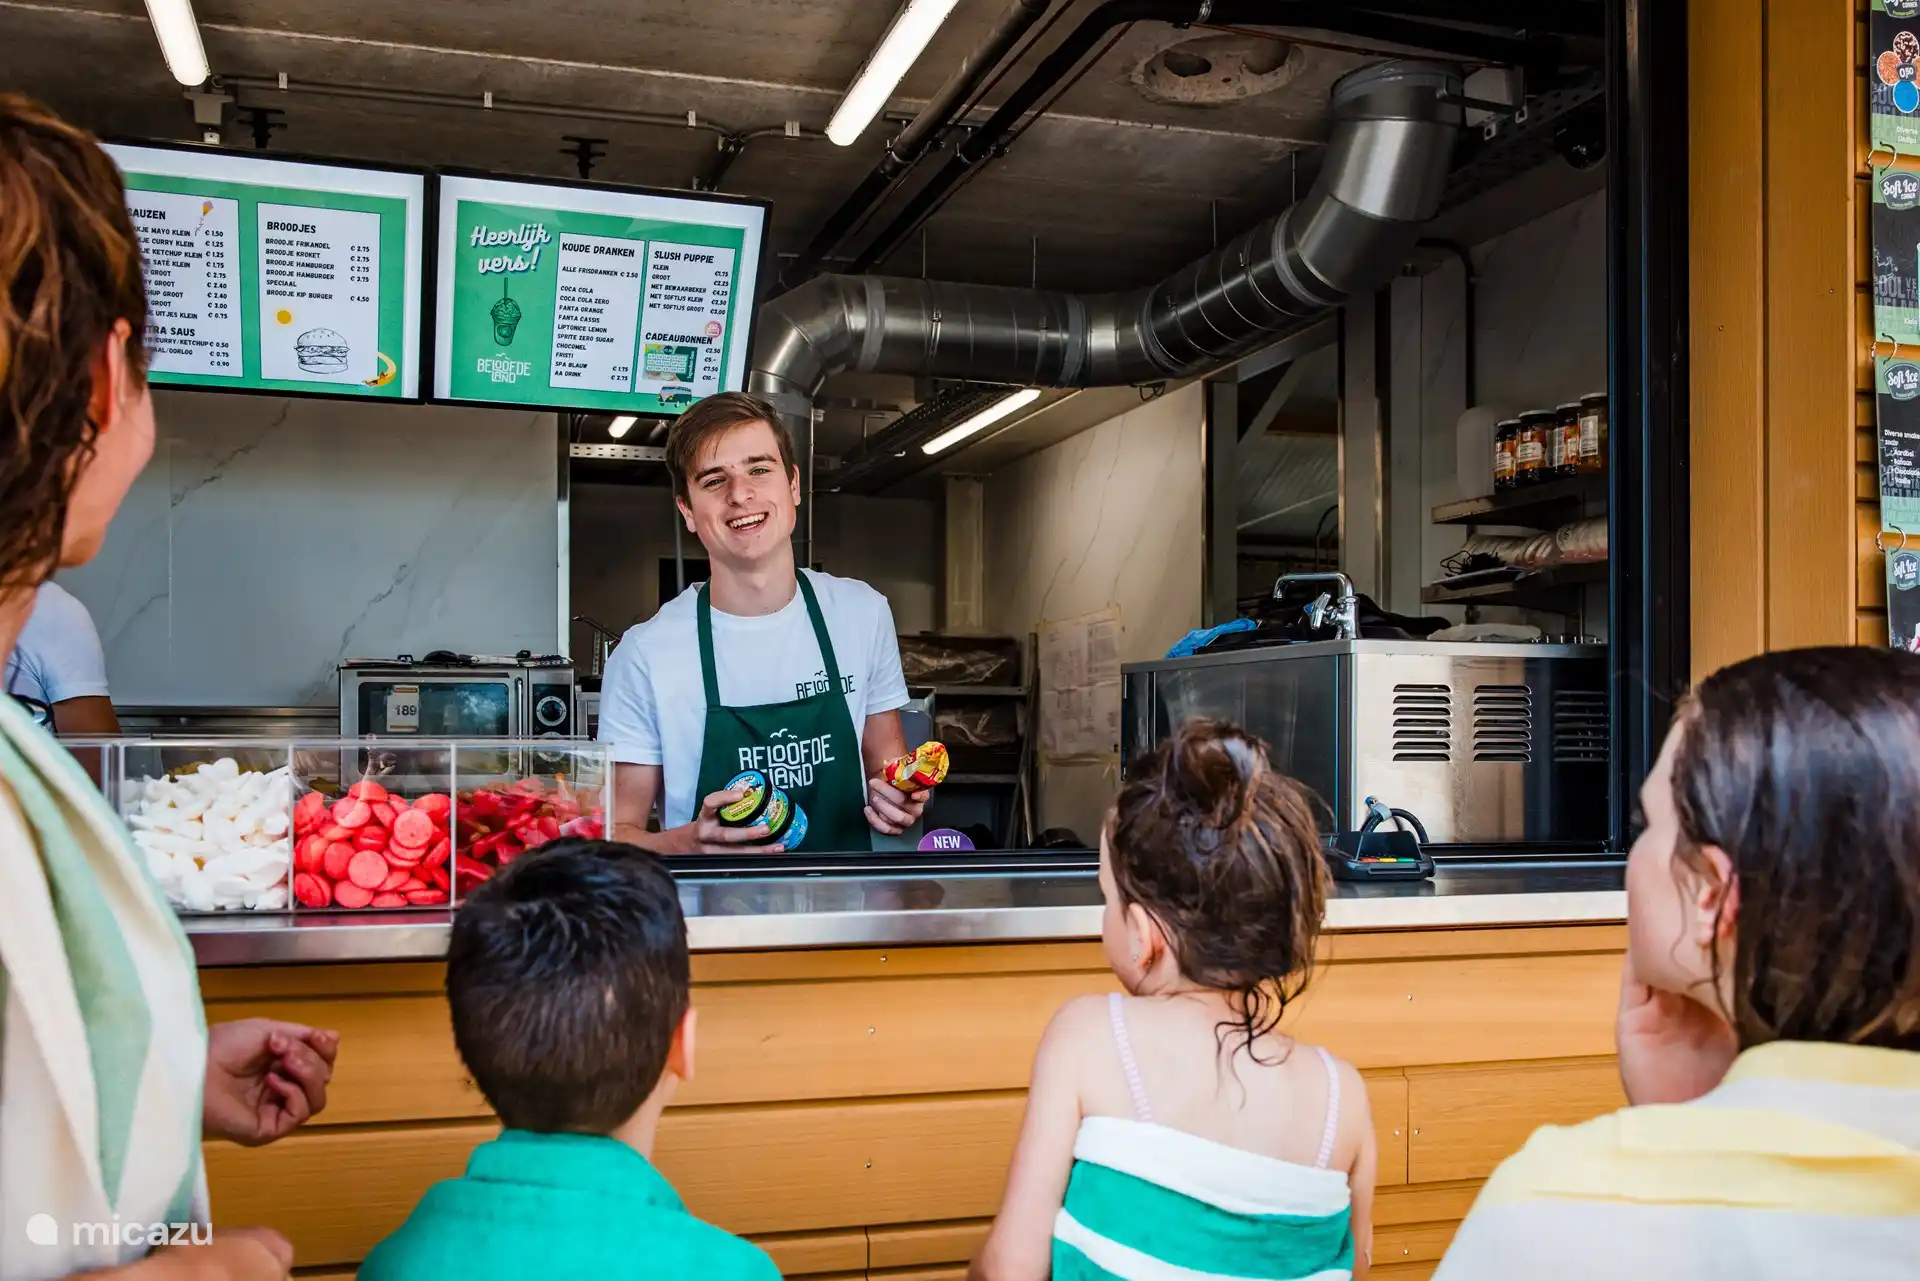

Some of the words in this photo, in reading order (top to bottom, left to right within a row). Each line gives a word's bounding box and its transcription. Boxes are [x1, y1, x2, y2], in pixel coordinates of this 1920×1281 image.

[1883, 180, 1902, 198] Soft
[1902, 179, 1917, 192] Ice
[151, 227, 170, 235] MAYO
[266, 221, 317, 234] BROODJES
[151, 238, 173, 246] CURRY
[470, 223, 552, 252] Heerlijk
[265, 238, 294, 246] BROODJE
[296, 241, 331, 249] FRIKANDEL
[152, 249, 182, 257] KETCHUP
[265, 248, 294, 256] BROODJE
[296, 251, 320, 259] KROKET
[562, 242, 591, 253] KOUDE
[593, 246, 635, 257] DRANKEN
[478, 246, 540, 274] vers!
[654, 250, 681, 261] SLUSH
[683, 253, 714, 264] PUPPIE
[265, 259, 294, 267] BROODJE
[296, 262, 334, 270] HAMBURGER
[150, 269, 172, 277] GROOT
[266, 269, 294, 277] BROODJE
[296, 272, 334, 280] HAMBURGER
[578, 267, 618, 276] FRISDRANKEN
[154, 279, 175, 287] GROOT
[266, 279, 297, 288] SPECIAAL
[664, 285, 707, 293] BEWAARBEKER
[308, 292, 333, 300] BURGER
[663, 294, 686, 302] SOFTIJS
[155, 310, 178, 318] UITJES
[580, 306, 604, 314] ORANGE
[558, 314, 578, 322] FANTA
[171, 327, 196, 337] SAUS
[557, 324, 586, 332] LIPTONICE
[645, 332, 713, 345] CADEAUBONNEN
[556, 342, 587, 350] CHOCOMEL
[491, 371, 516, 383] LAND
[1888, 370, 1905, 388] Soft
[1905, 369, 1919, 383] Ice
[1884, 429, 1903, 438] Diverse
[1893, 561, 1906, 579] Soft
[1905, 559, 1917, 573] Ice
[395, 705, 417, 716] 189
[933, 835, 961, 849] NEW
